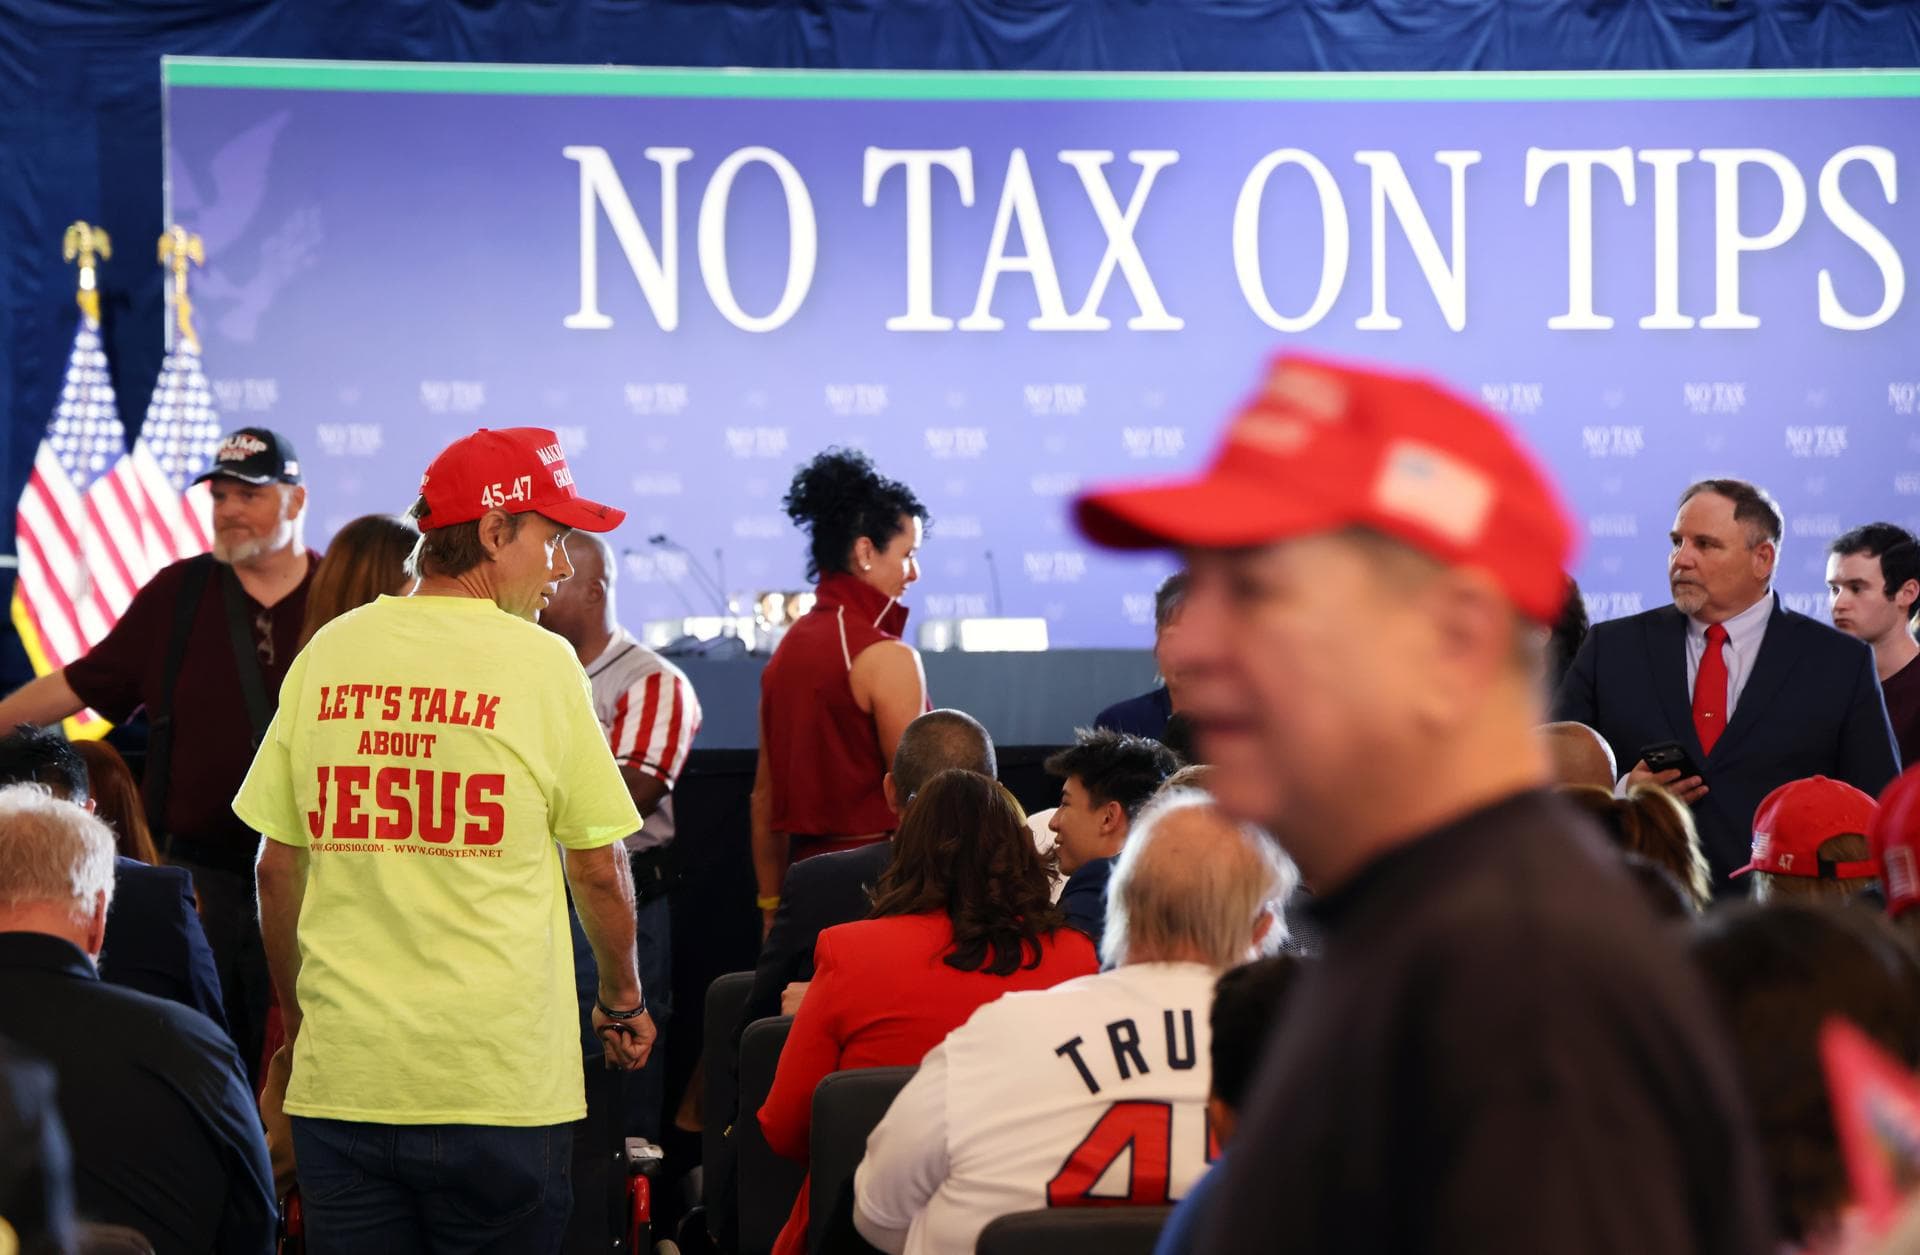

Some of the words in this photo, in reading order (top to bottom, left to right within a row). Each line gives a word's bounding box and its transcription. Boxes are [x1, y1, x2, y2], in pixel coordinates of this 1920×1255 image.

[562, 145, 817, 333] NO
[862, 145, 1185, 332] TAX
[1232, 147, 1482, 333] ON
[1524, 145, 1905, 332] TIPS
[481, 475, 532, 509] 45-47
[317, 684, 402, 721] LET'S
[408, 686, 501, 730] TALK
[357, 730, 437, 759] ABOUT
[307, 765, 506, 846] JESUS
[1054, 1009, 1197, 1096] TRU
